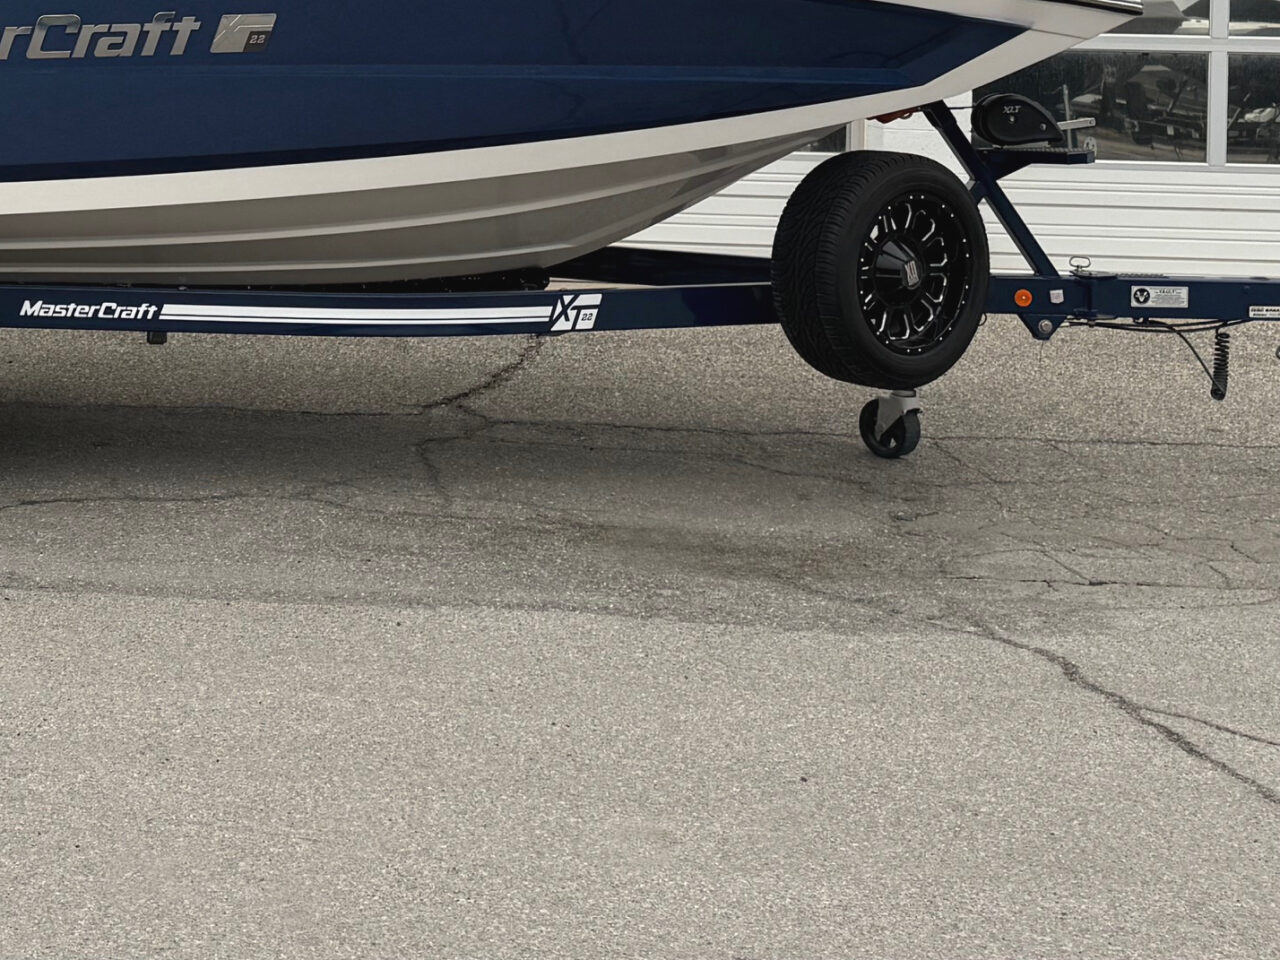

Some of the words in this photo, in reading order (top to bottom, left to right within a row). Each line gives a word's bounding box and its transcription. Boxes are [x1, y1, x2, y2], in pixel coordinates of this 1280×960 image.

[250, 34, 265, 44] 22
[1002, 105, 1021, 114] XLT
[20, 300, 158, 320] MasterCraft
[581, 313, 593, 321] 22
